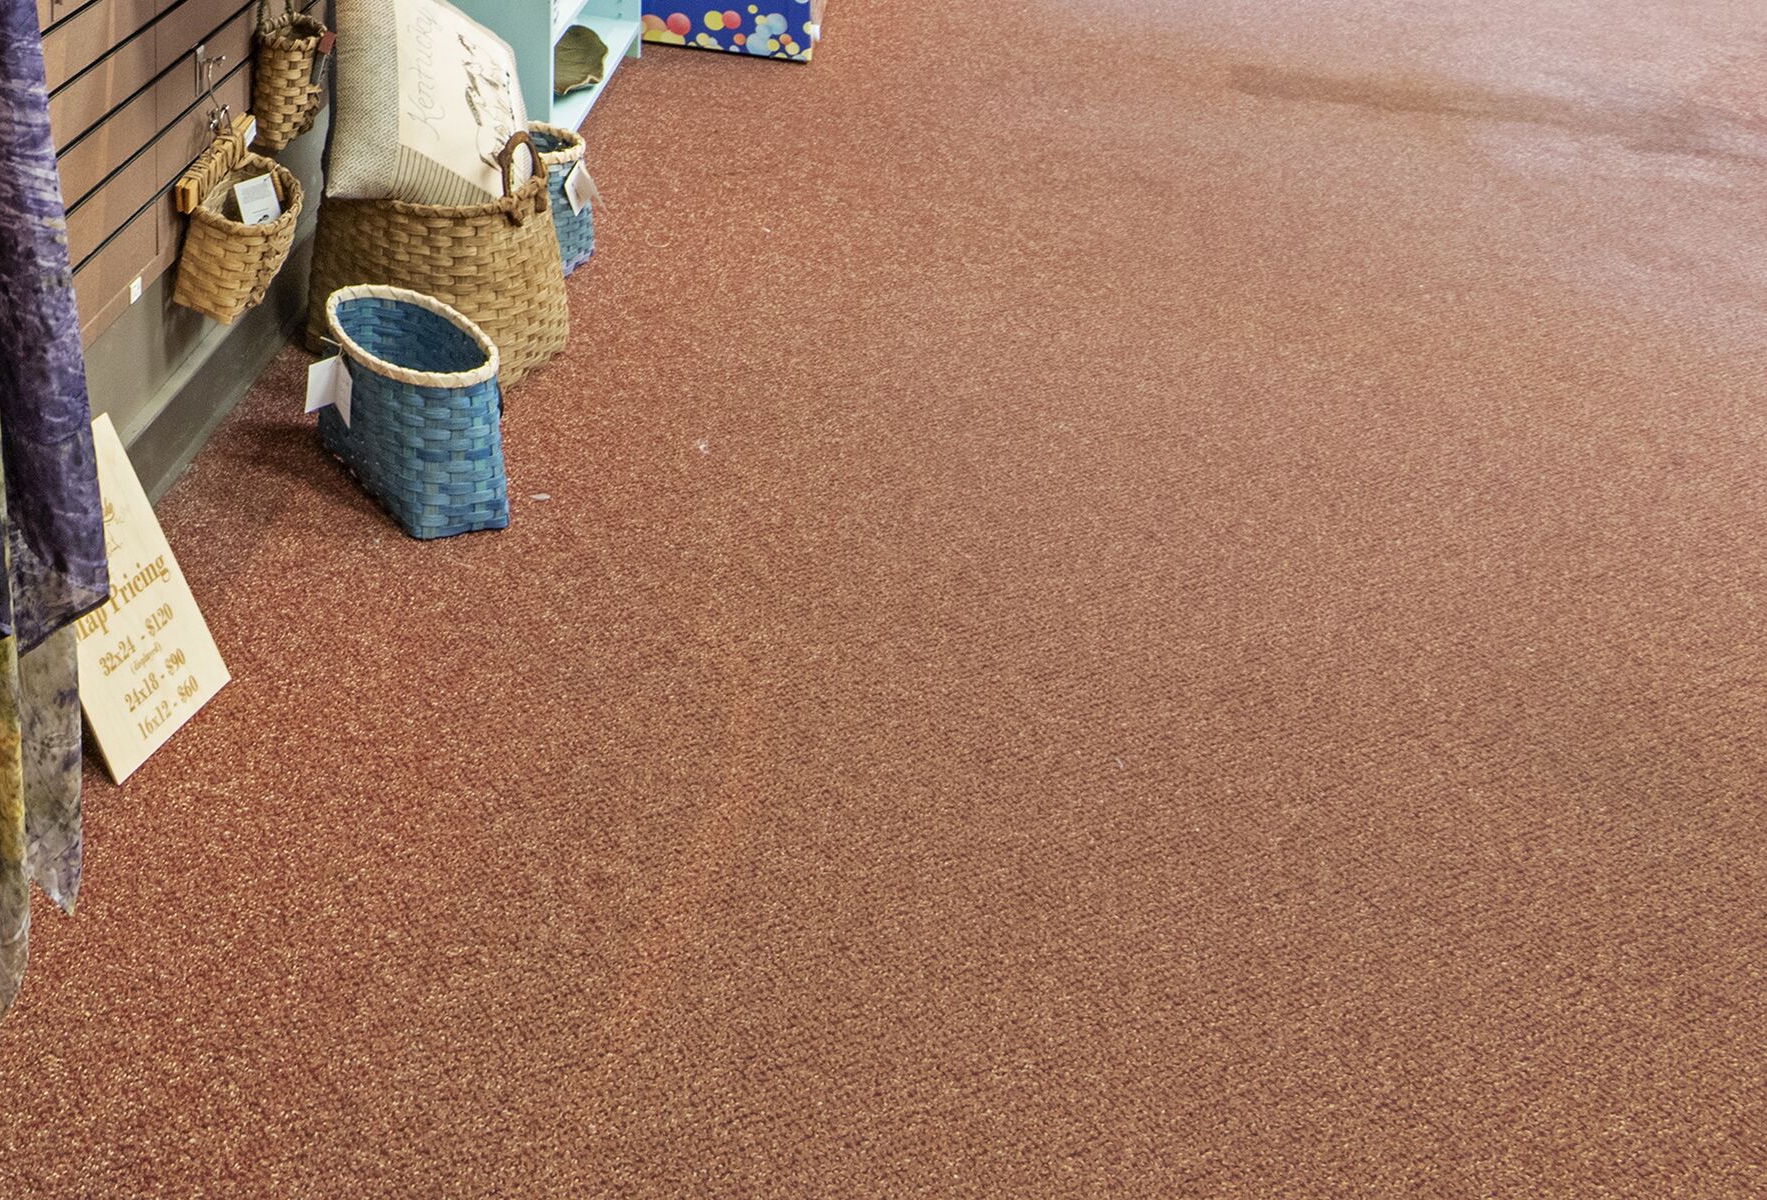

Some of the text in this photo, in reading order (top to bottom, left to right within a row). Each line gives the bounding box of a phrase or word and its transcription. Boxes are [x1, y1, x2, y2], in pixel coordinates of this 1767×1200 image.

[407, 5, 446, 142] Kentucky
[109, 554, 171, 614] Pricing
[98, 635, 136, 677] 32x24
[144, 603, 174, 637] $120
[124, 672, 160, 713] 24x18
[164, 648, 186, 676] $90
[137, 700, 172, 740] 16x12
[176, 674, 199, 704] $60
